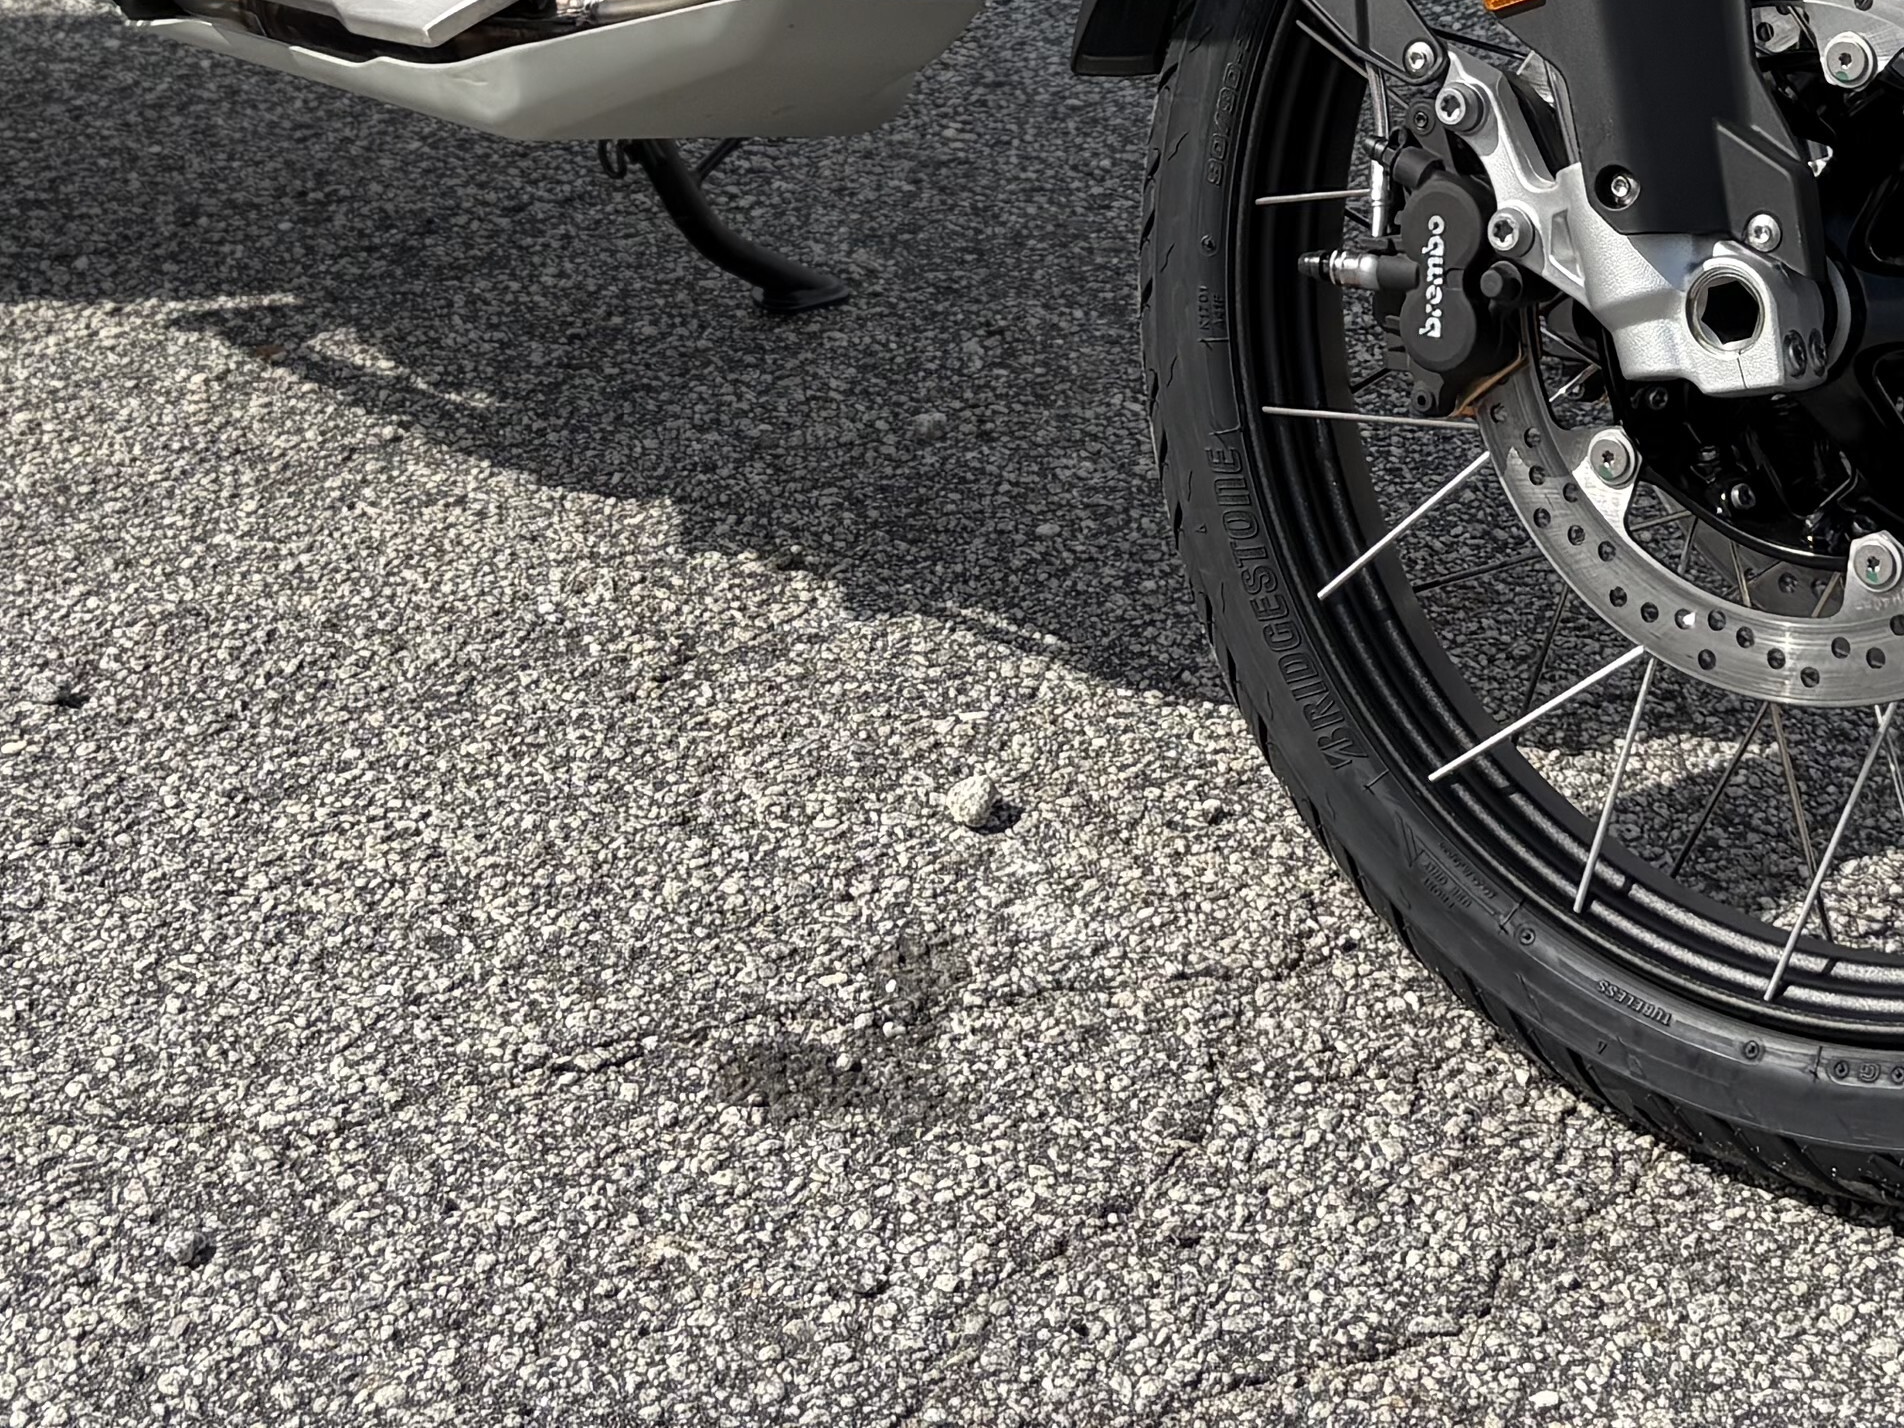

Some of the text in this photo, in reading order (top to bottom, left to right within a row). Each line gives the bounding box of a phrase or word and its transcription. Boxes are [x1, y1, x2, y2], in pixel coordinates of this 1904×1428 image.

[1418, 214, 1447, 339] brembo
[1206, 445, 1369, 771] BRIDGESTONE
[1597, 977, 1674, 1028] TUBELESS
